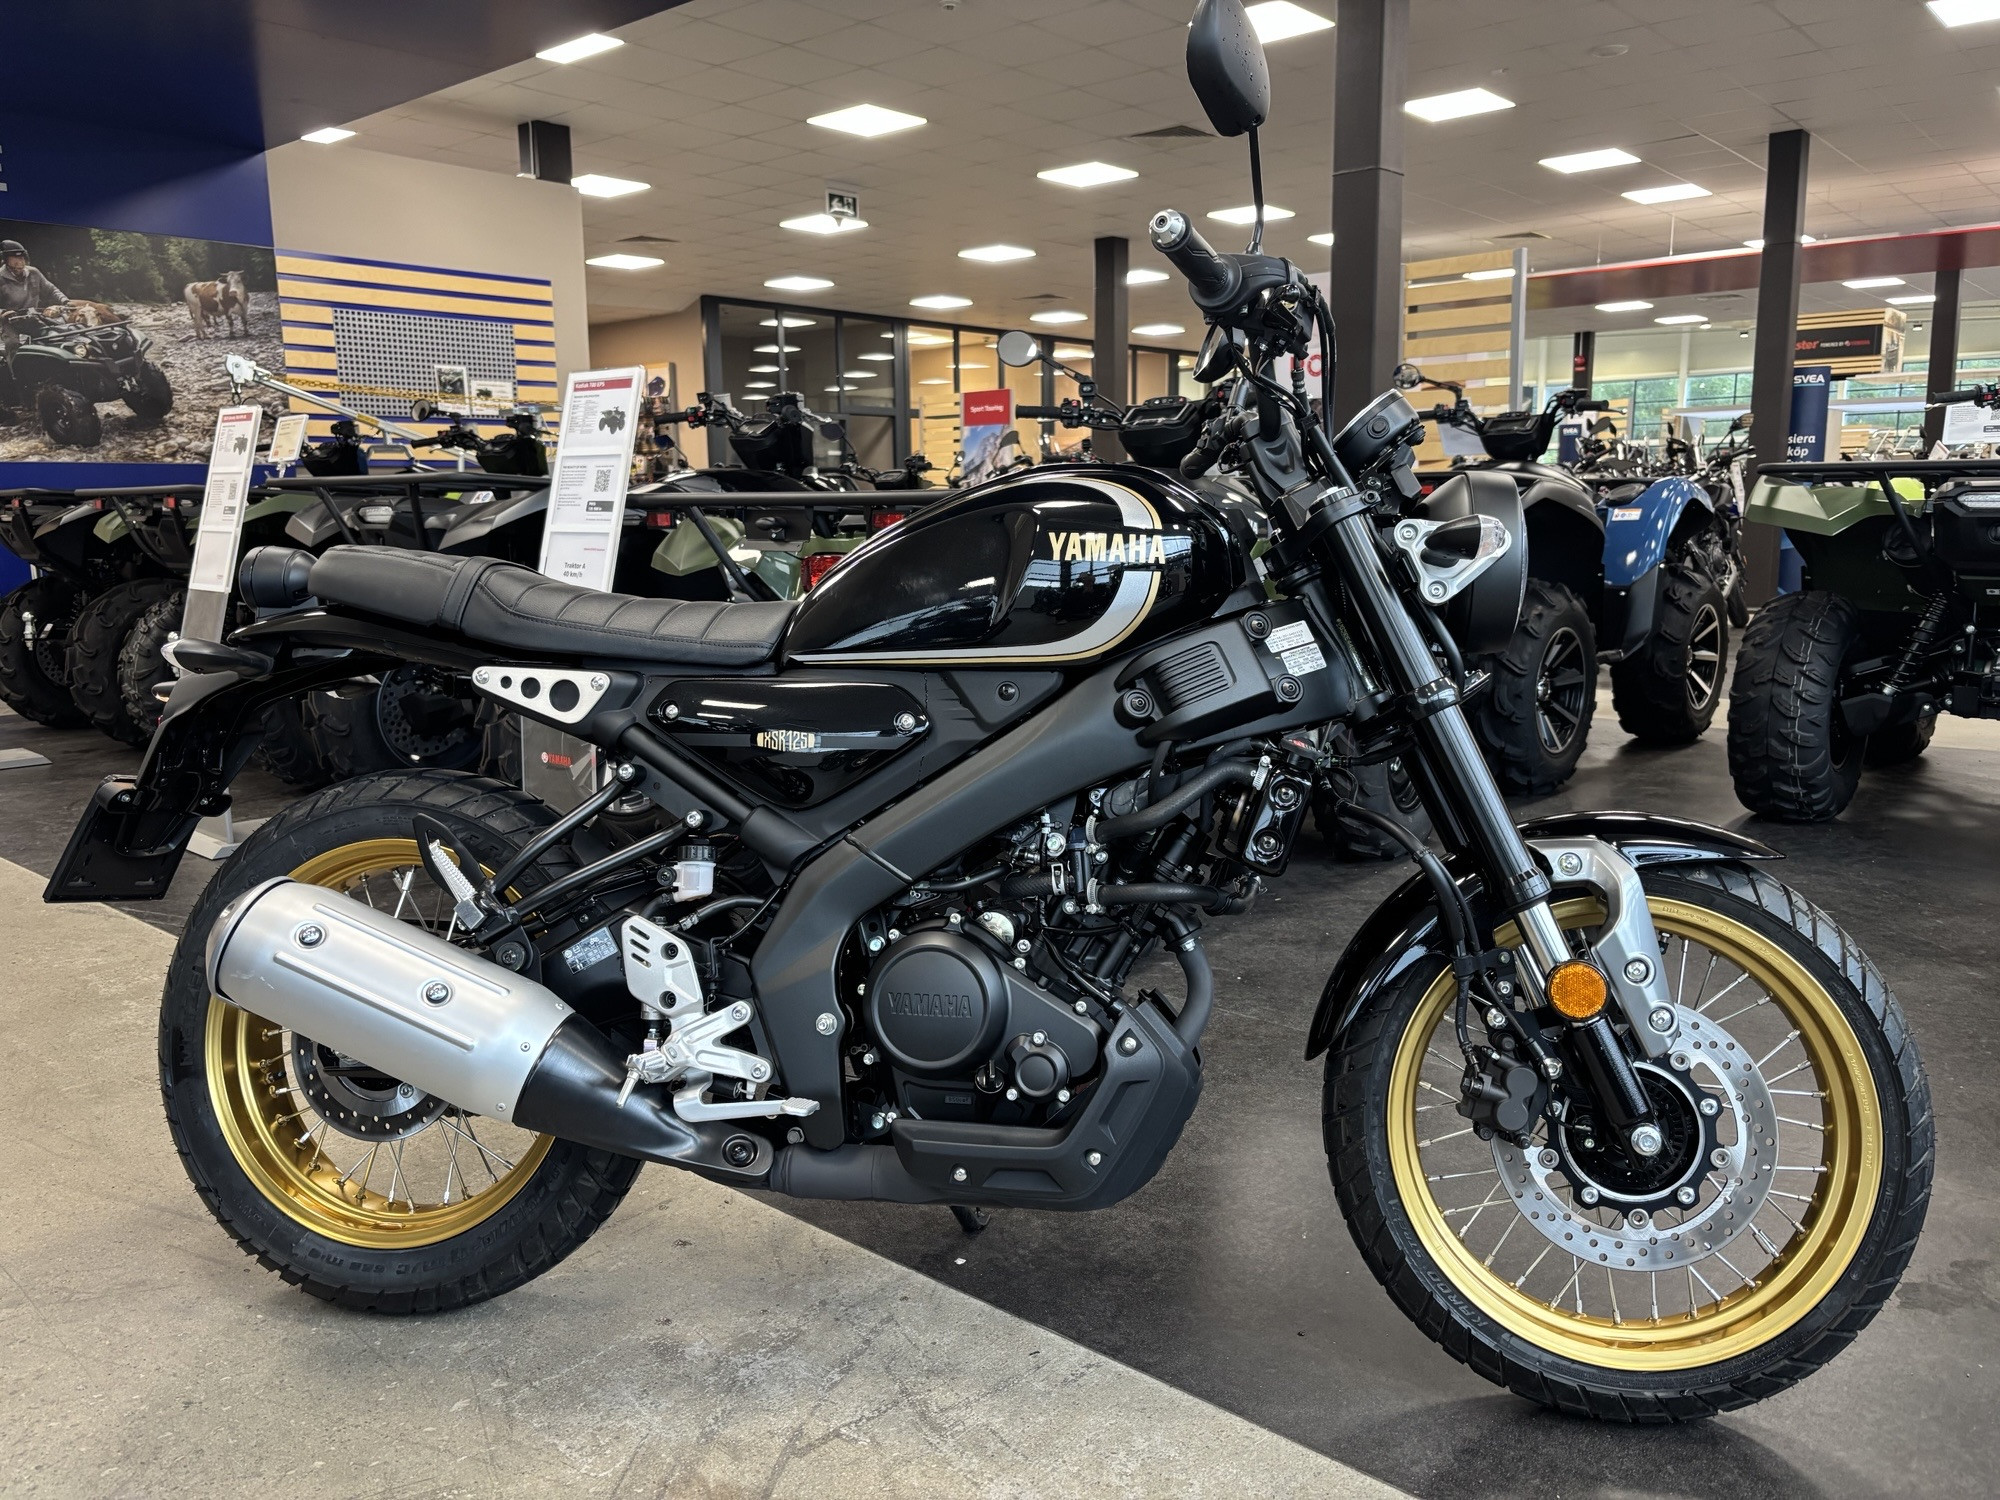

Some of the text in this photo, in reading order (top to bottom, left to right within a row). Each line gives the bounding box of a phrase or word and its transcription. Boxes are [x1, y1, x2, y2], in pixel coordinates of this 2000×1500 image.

[1793, 374, 1825, 384] SVEA
[970, 405, 1004, 414] Sport Touring
[1786, 446, 1809, 458] köp
[1048, 532, 1166, 564] YAMAHA
[764, 729, 808, 747] XSR125
[548, 752, 572, 767] YAMAHA
[888, 992, 972, 1018] YAMAHA
[1859, 1182, 1896, 1266] METZELER
[1426, 1269, 1486, 1328] KAROO
